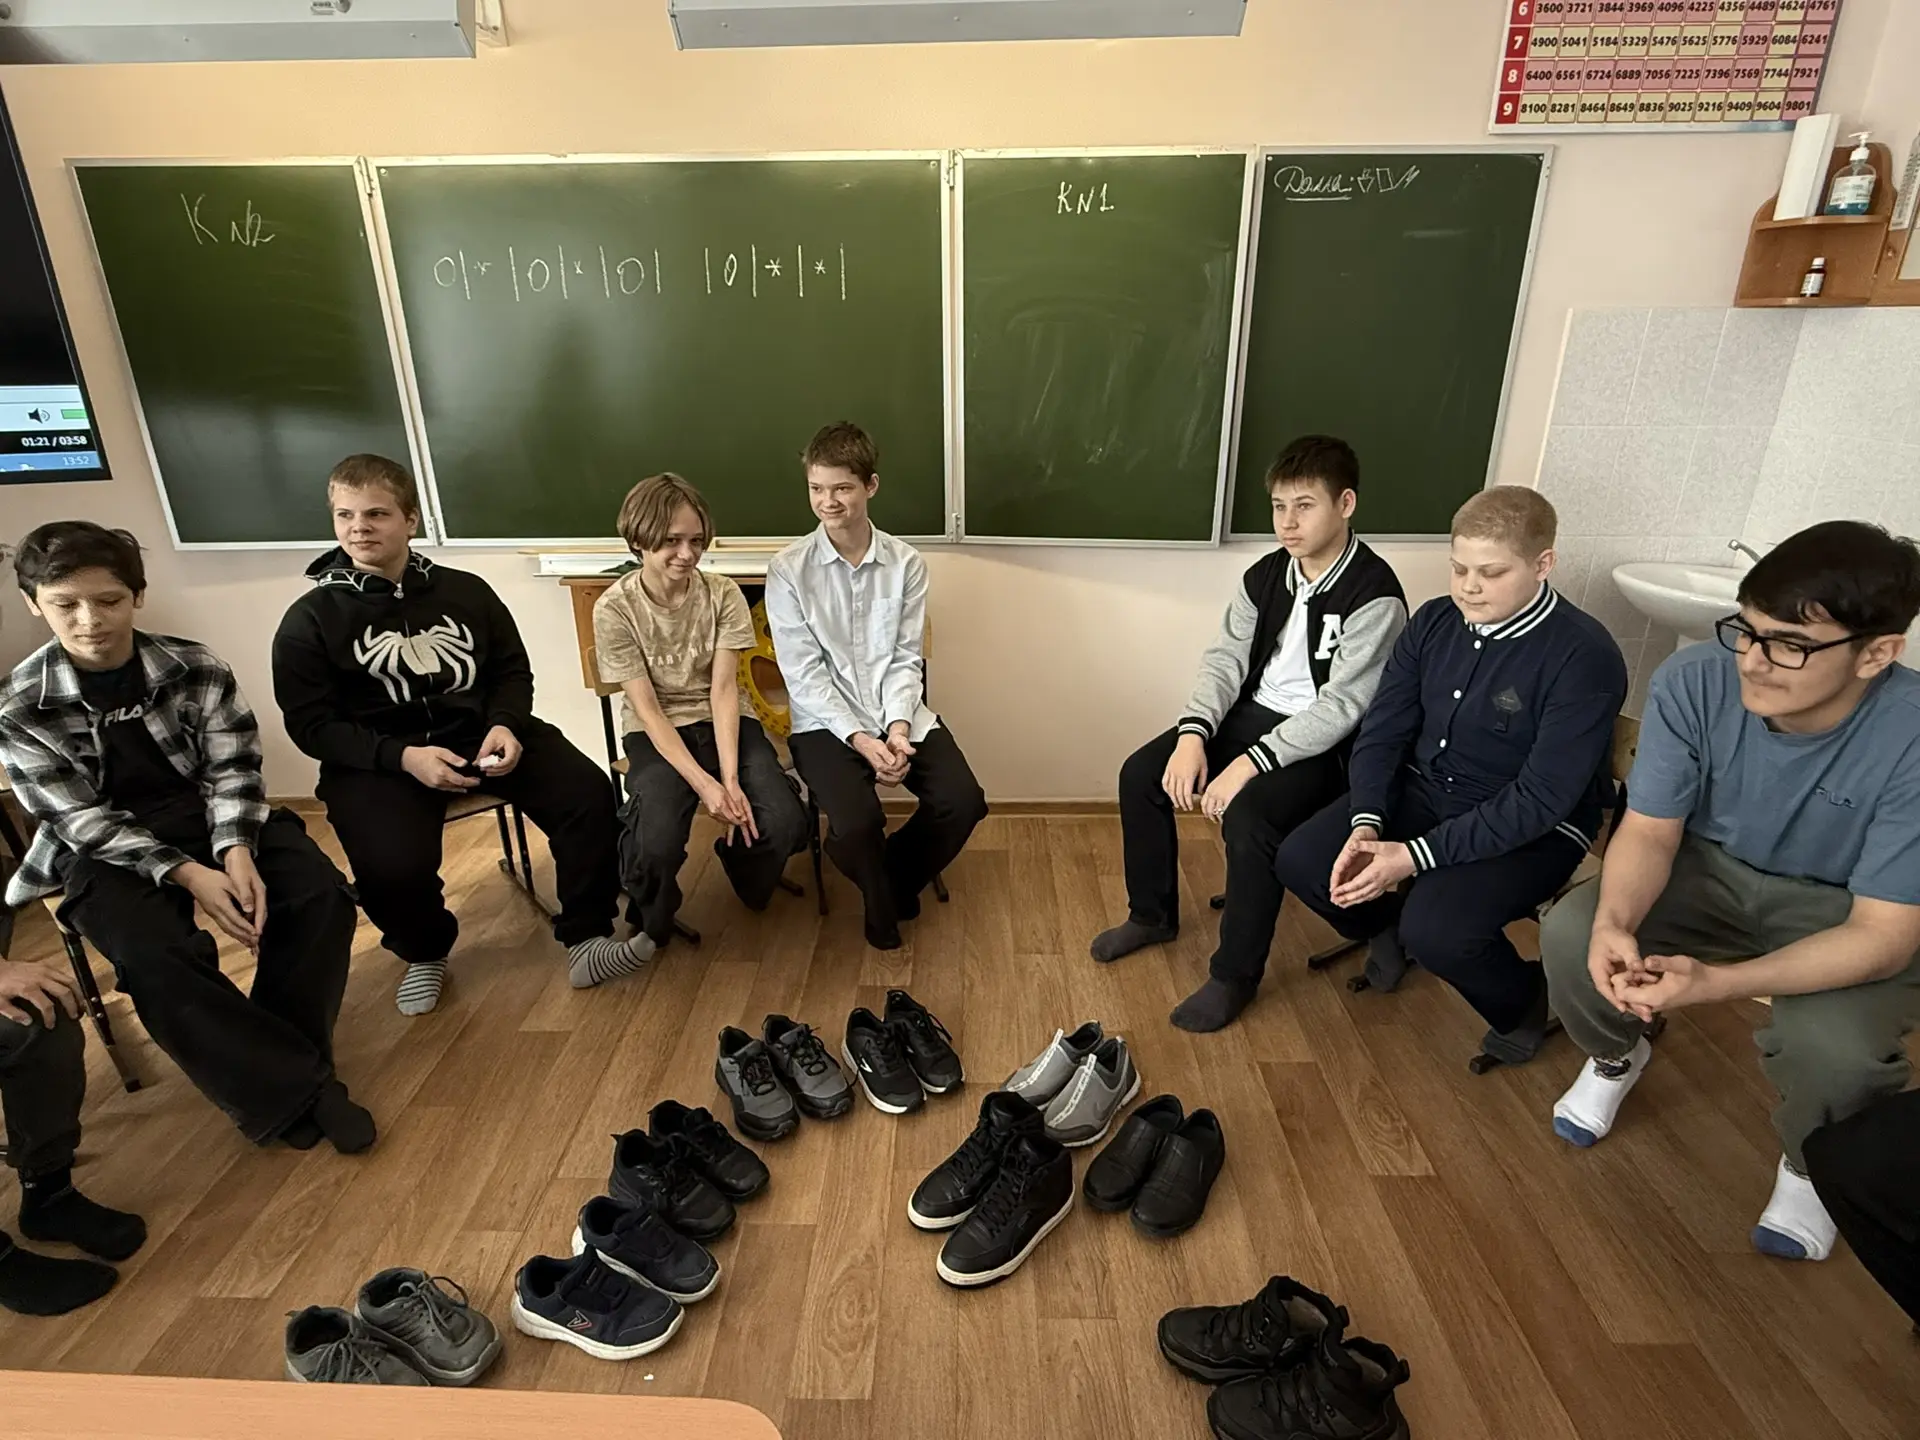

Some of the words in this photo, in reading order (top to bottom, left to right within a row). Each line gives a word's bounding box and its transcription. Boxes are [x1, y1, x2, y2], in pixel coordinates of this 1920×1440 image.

[1518, 1, 1528, 16] 6
[1536, 2, 1564, 13] 3600
[1567, 2, 1593, 13] 3721
[1598, 1, 1625, 12] 3844
[1627, 1, 1654, 12] 3969
[1657, 1, 1684, 12] 4096
[1687, 1, 1714, 12] 4225
[1718, 1, 1745, 12] 4356
[1748, 1, 1775, 11] 4489
[1779, 1, 1805, 11] 4624
[1808, 1, 1836, 11] 4761
[1513, 36, 1523, 49] 7
[1531, 36, 1558, 47] 4900
[1562, 36, 1587, 47] 5041
[1592, 36, 1618, 46] 5184
[1622, 36, 1647, 46] 5329
[1651, 36, 1677, 46] 5476
[1682, 36, 1707, 46] 5625
[1712, 36, 1738, 46] 5776
[1742, 35, 1767, 45] 5929
[1771, 35, 1797, 45] 6084
[1801, 34, 1828, 45] 6241
[1507, 69, 1518, 83] 8
[1526, 70, 1552, 81] 6400
[1556, 70, 1581, 80] 6561
[1586, 70, 1611, 80] 6724
[1615, 70, 1641, 80] 6889
[1645, 69, 1671, 80] 7056
[1675, 69, 1700, 79] 7225
[1705, 69, 1730, 79] 7396
[1734, 68, 1760, 79] 7569
[1764, 68, 1789, 78] 7744
[1793, 68, 1819, 78] 7921
[1503, 102, 1513, 115] 9
[1520, 103, 1547, 114] 8100
[1550, 103, 1576, 113] 8281
[1580, 103, 1605, 113] 8464
[1609, 103, 1635, 113] 8649
[1639, 103, 1664, 113] 8836
[1668, 102, 1693, 112] 9025
[1698, 102, 1723, 112] 9216
[1727, 102, 1752, 112] 9409
[1756, 102, 1782, 111] 9604
[1785, 101, 1811, 111] 9801
[21, 436, 51, 447] 01:21
[58, 435, 88, 446] 03:58
[62, 455, 91, 466] 13:52
[1314, 613, 1342, 660] A
[104, 703, 144, 727] FILA
